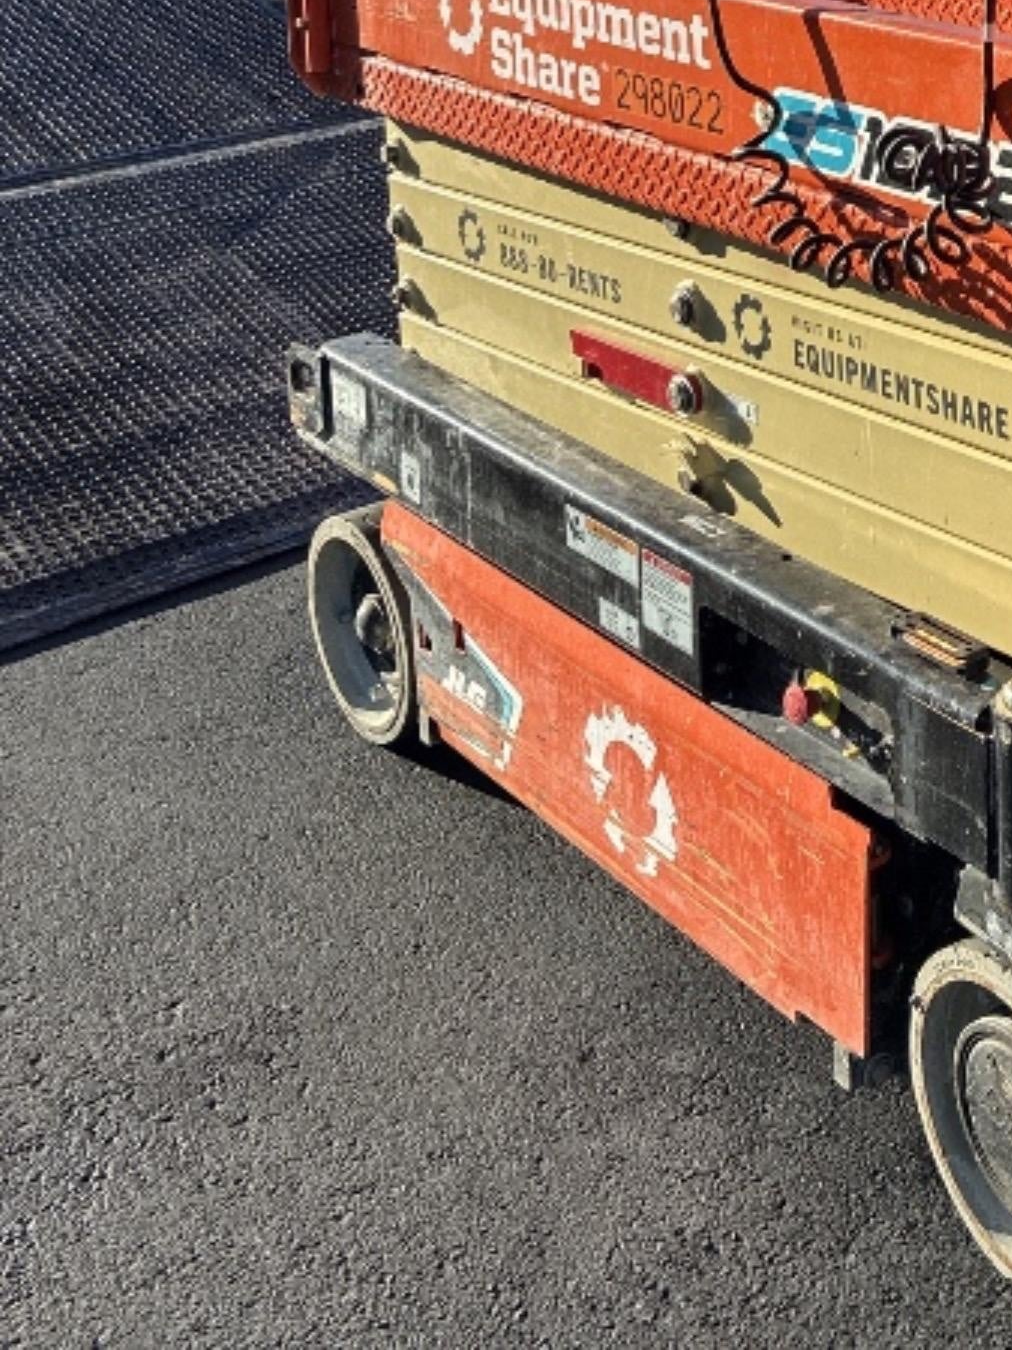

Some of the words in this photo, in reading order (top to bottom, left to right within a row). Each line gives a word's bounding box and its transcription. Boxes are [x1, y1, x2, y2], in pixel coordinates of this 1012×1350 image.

[490, 27, 602, 107] Share
[614, 67, 725, 136] 298022
[441, 664, 488, 710] JLG
